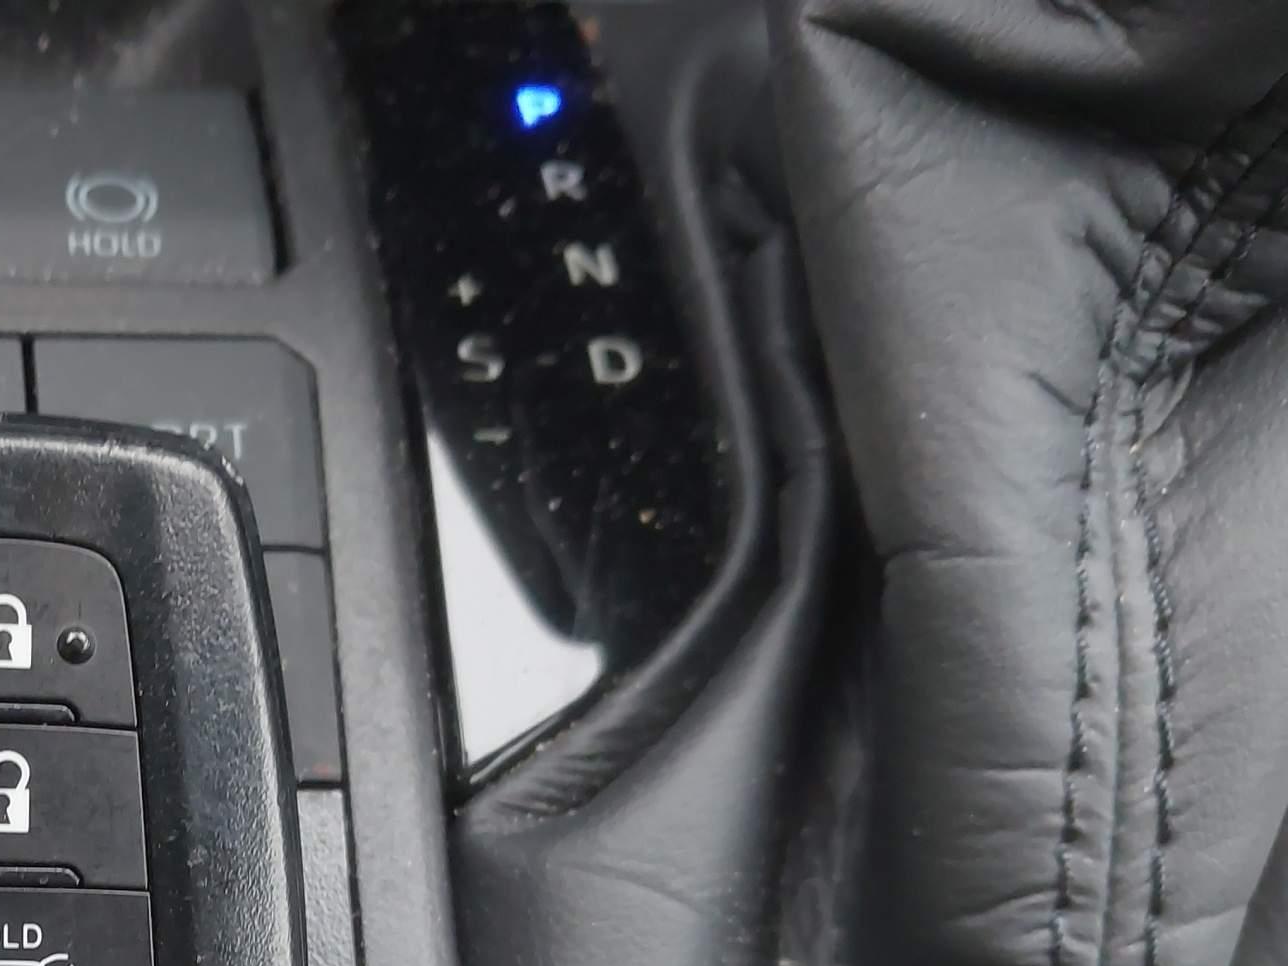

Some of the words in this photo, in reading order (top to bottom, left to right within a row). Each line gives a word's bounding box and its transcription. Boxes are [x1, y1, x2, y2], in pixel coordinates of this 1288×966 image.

[517, 85, 561, 128] P
[540, 160, 586, 200] R
[68, 230, 161, 257] HOLD
[564, 243, 618, 287] N
[457, 334, 505, 382] S
[588, 337, 643, 384] D
